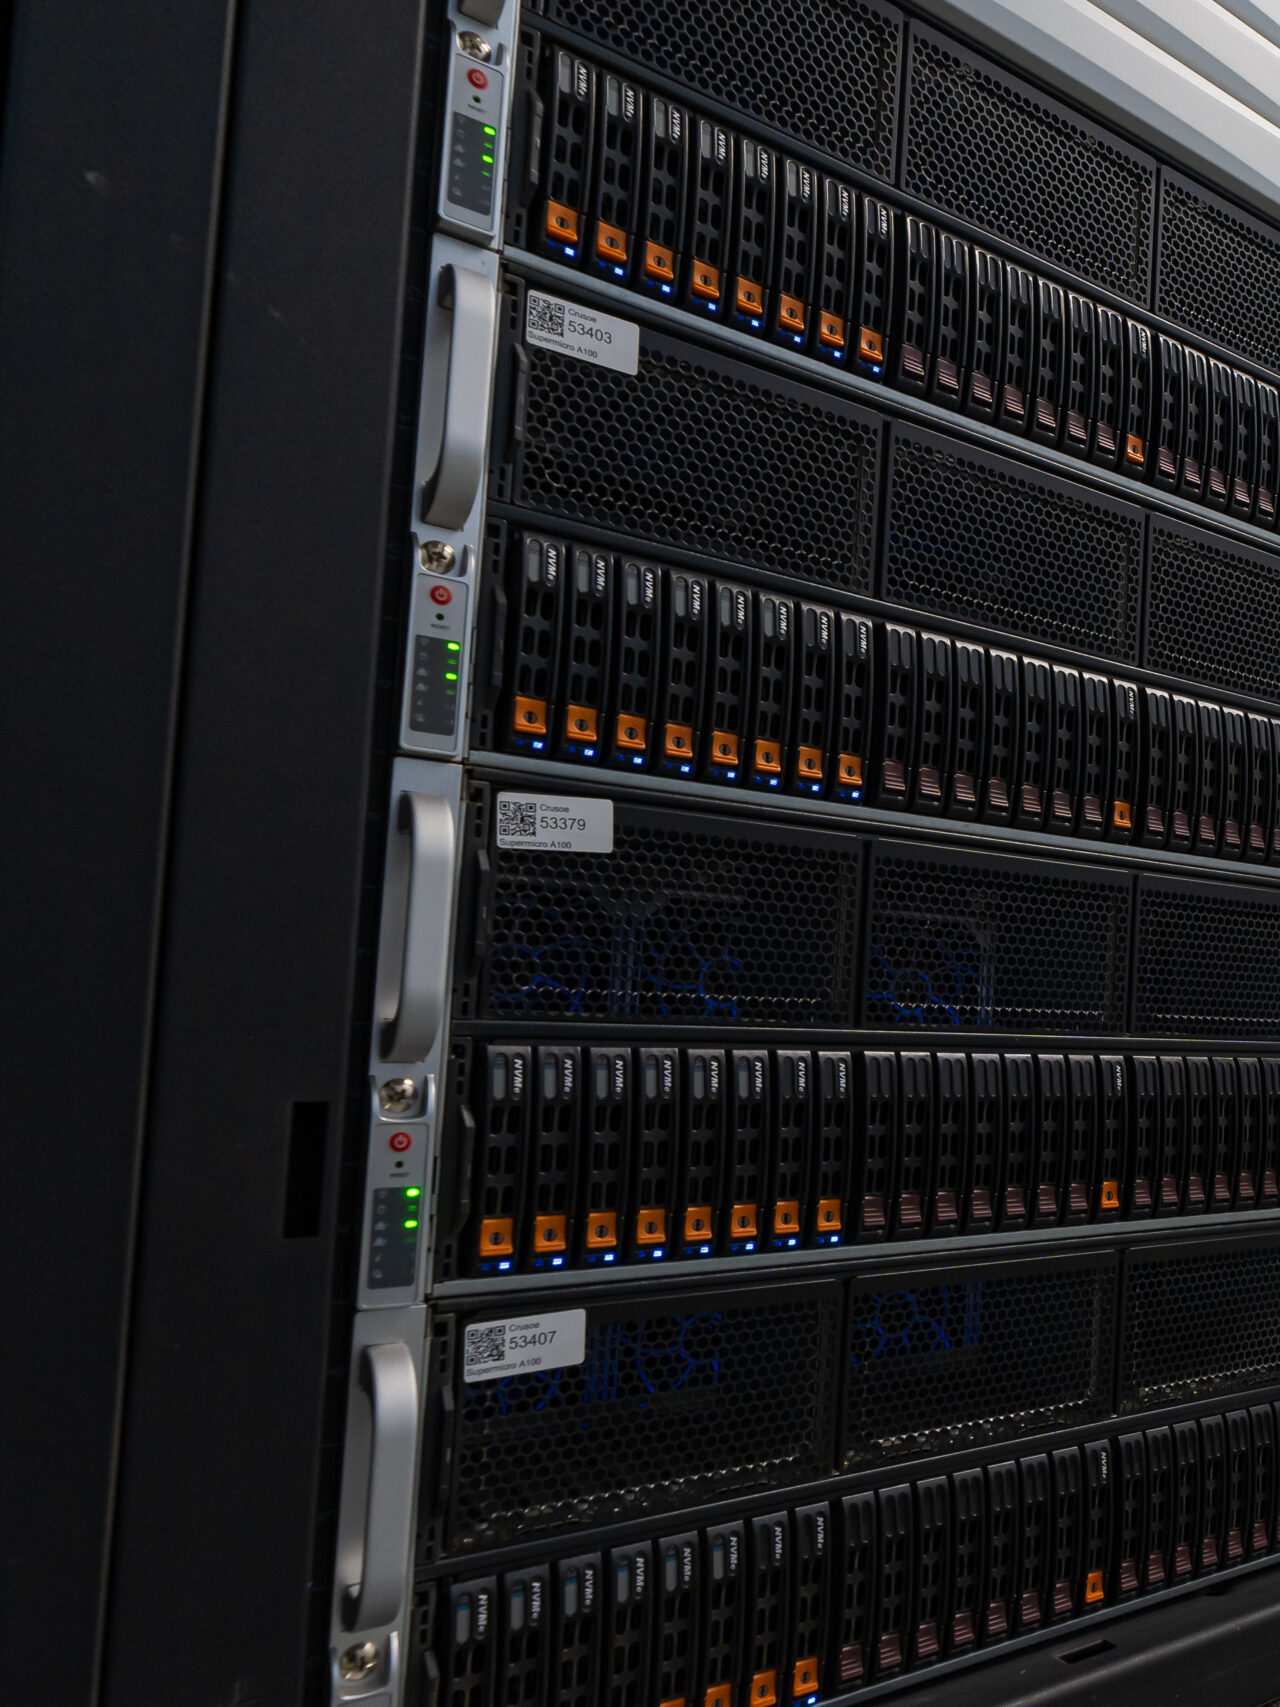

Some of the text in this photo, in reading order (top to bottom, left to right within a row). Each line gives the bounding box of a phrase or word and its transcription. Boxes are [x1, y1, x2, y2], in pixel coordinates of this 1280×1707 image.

[578, 64, 588, 95] NVMe
[626, 88, 634, 117] NVMe
[672, 111, 681, 139] NVMe
[717, 132, 726, 160] NVMe
[760, 151, 768, 179] NVMe
[802, 171, 810, 198] NVMe
[568, 308, 597, 323] Crusoe
[527, 331, 598, 358] Supermicro A100
[567, 320, 612, 344] 53403
[546, 549, 557, 580] NVMe
[596, 559, 606, 591] NVMe
[645, 572, 653, 602] NVMe
[691, 584, 700, 614] NVMe
[737, 595, 745, 625] NVMe
[779, 606, 787, 635] NVMe
[540, 804, 570, 814] Crusoe
[540, 817, 586, 831] 53379
[499, 838, 572, 849] Supermicro A100
[512, 1059, 523, 1094] NVMe
[563, 1059, 573, 1093] NVMe
[615, 1060, 624, 1093] NVMe
[663, 1060, 672, 1092] NVMe
[710, 1061, 719, 1093] NVMe
[754, 1061, 763, 1093] NVMe
[798, 1062, 806, 1092] NVMe
[508, 1322, 540, 1332] Crusoe
[508, 1330, 557, 1350] 53407
[466, 1357, 542, 1377] Supermicro A100
[774, 1527, 783, 1560] NVMe
[816, 1517, 824, 1549] NVMe
[683, 1548, 692, 1582] NVMe
[730, 1537, 738, 1570] NVMe
[584, 1569, 593, 1606] NVMe
[635, 1557, 645, 1593] NVMe
[477, 1594, 488, 1633] NVMe
[531, 1582, 541, 1619] NVMe
